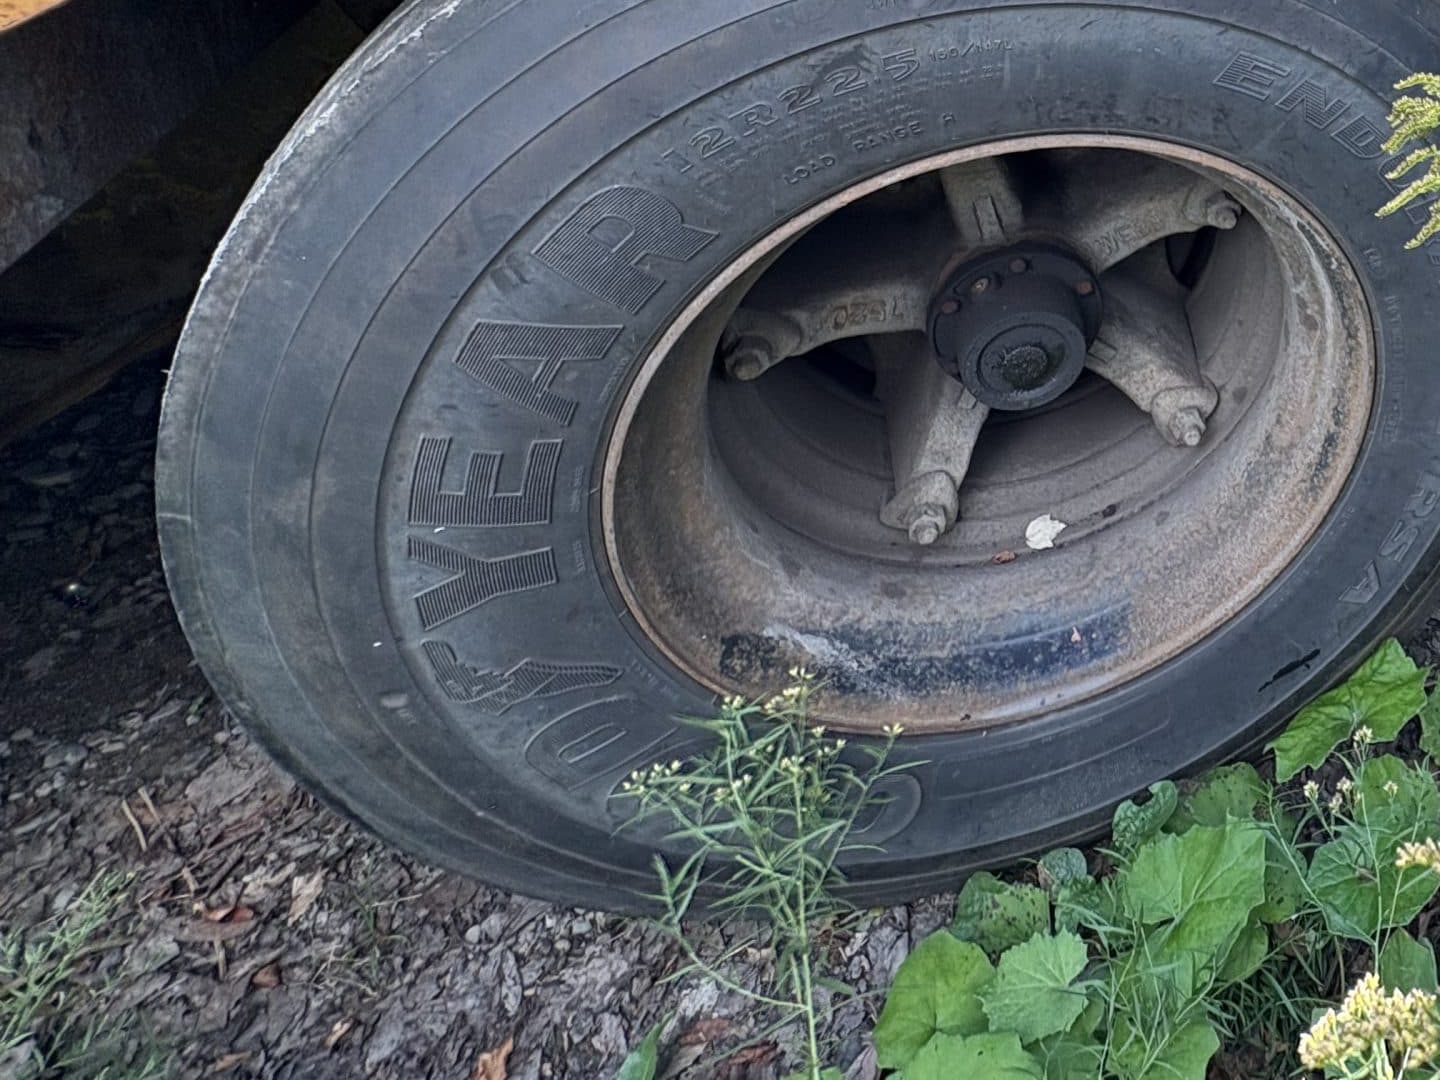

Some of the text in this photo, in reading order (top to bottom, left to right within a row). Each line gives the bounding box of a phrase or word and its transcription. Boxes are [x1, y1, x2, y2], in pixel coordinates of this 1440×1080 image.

[661, 48, 920, 174] 12R22.5
[783, 153, 836, 185] LOAD
[853, 120, 925, 153] RANGE
[407, 183, 922, 848] DYEAR
